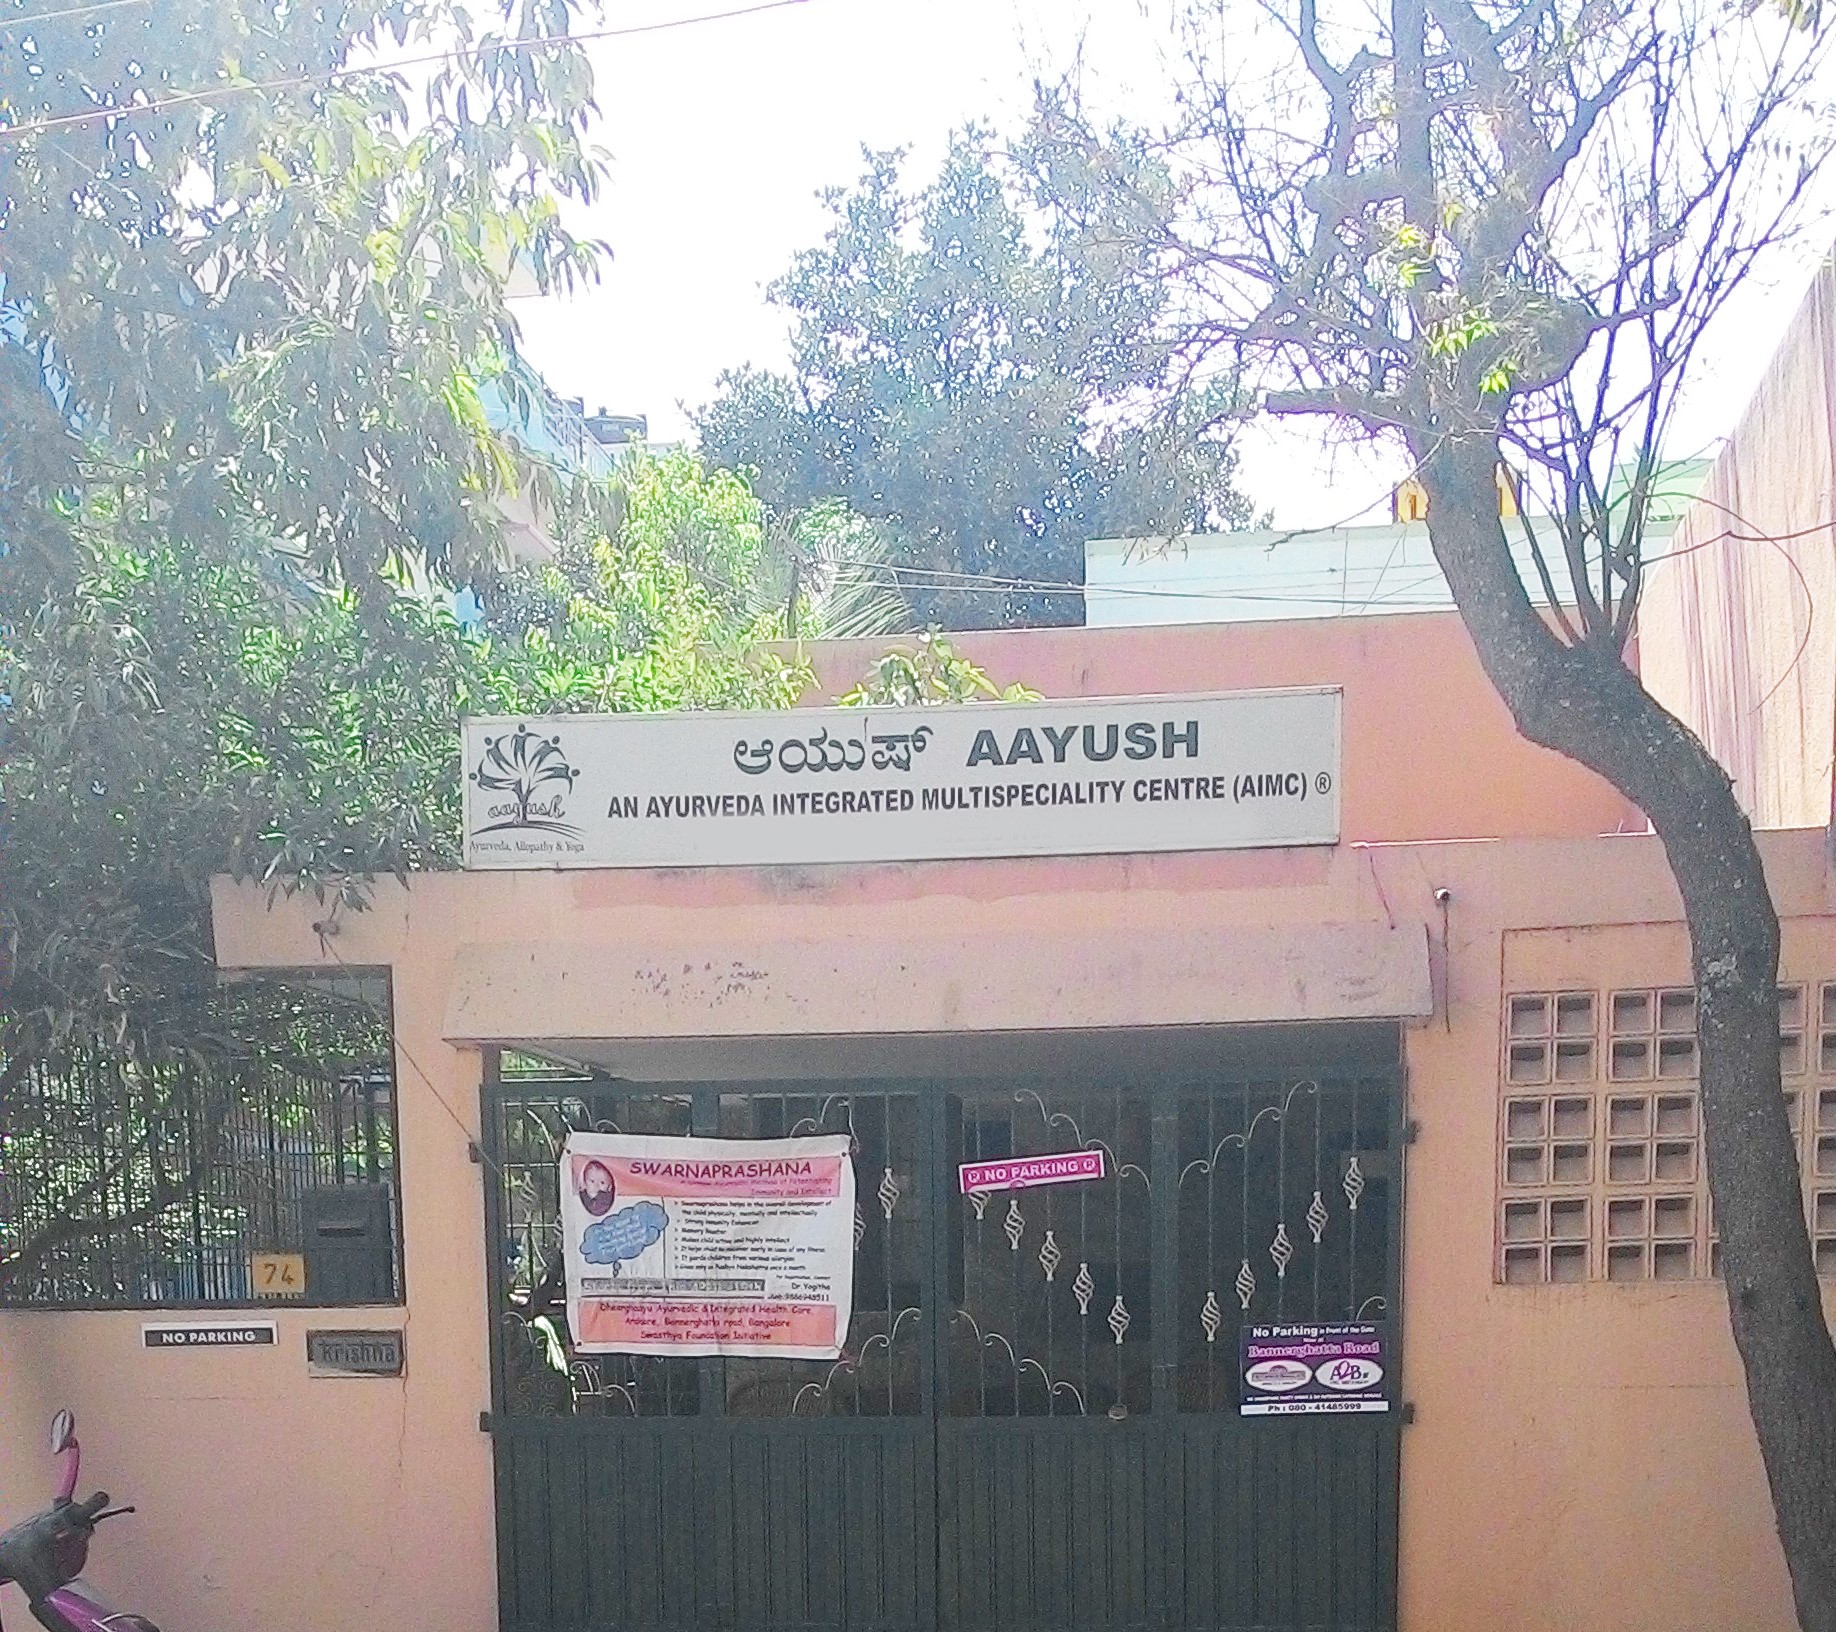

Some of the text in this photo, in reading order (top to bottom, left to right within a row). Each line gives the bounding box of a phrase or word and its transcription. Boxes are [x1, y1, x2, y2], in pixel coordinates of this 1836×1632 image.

[965, 720, 1199, 767] AAYUSH
[607, 796, 638, 818] AN
[646, 794, 765, 817] AYURVEDA
[772, 789, 914, 816] INTEGRATED
[922, 779, 1126, 810] MULTISPECIALITY
[1133, 776, 1225, 802] CENTRE
[1232, 772, 1307, 803] (AIMC)
[630, 1161, 812, 1178] SWARNAPRASHANA
[985, 1160, 1078, 1182] NO PARKING
[263, 1263, 294, 1285] 74
[656, 1303, 698, 1314] Ayurvedic
[749, 1317, 791, 1328] Bangalore
[162, 1331, 256, 1343] NO PARKING
[1252, 1327, 1269, 1338] No
[1272, 1325, 1318, 1338] Parking
[1343, 1341, 1380, 1355] Road
